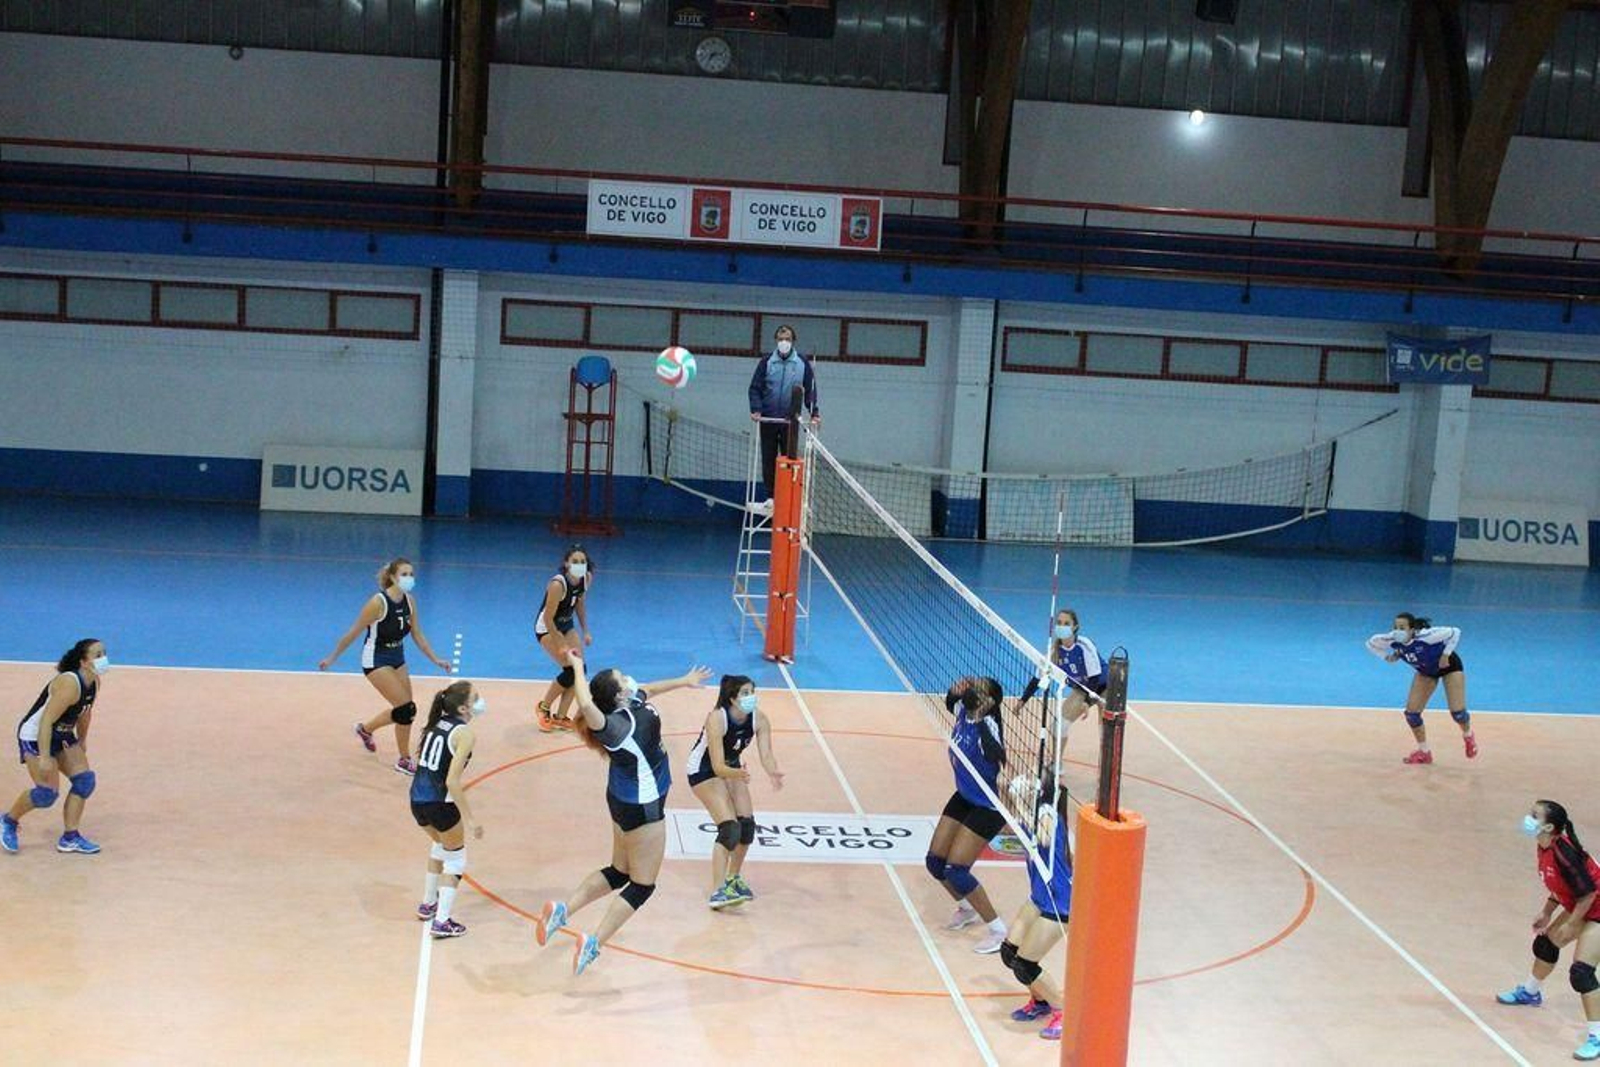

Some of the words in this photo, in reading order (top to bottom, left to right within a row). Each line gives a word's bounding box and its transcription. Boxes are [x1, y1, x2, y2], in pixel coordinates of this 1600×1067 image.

[598, 193, 677, 210] CONCELLO
[606, 209, 627, 222] DE
[631, 210, 667, 224] VIGO
[749, 202, 827, 219] CONCELLO
[758, 218, 778, 231] DE
[783, 219, 817, 233] VIGO
[301, 465, 411, 493] UORSA
[1483, 519, 1579, 546] UORSA
[419, 731, 444, 771] 10
[698, 823, 912, 837] CNCELLO
[795, 838, 894, 849] VIGO
